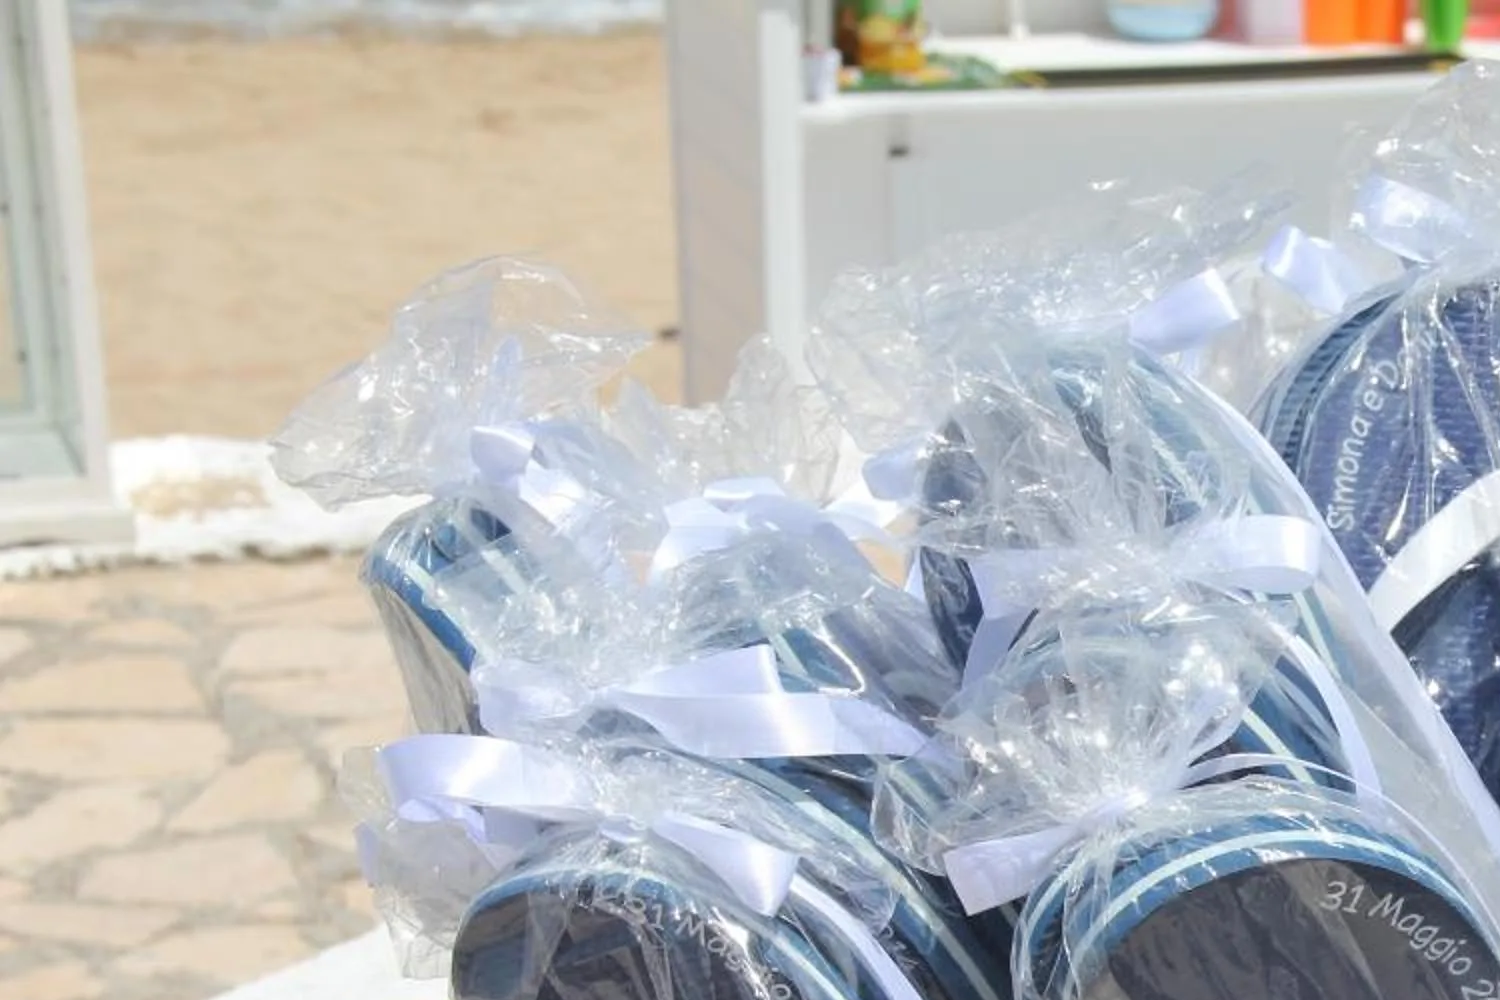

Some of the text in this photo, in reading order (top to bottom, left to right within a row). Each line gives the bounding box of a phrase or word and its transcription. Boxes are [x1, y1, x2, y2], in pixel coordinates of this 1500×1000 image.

[1326, 415, 1372, 532] Simona
[1319, 880, 1365, 914] 31
[1368, 892, 1473, 976] Maggio
